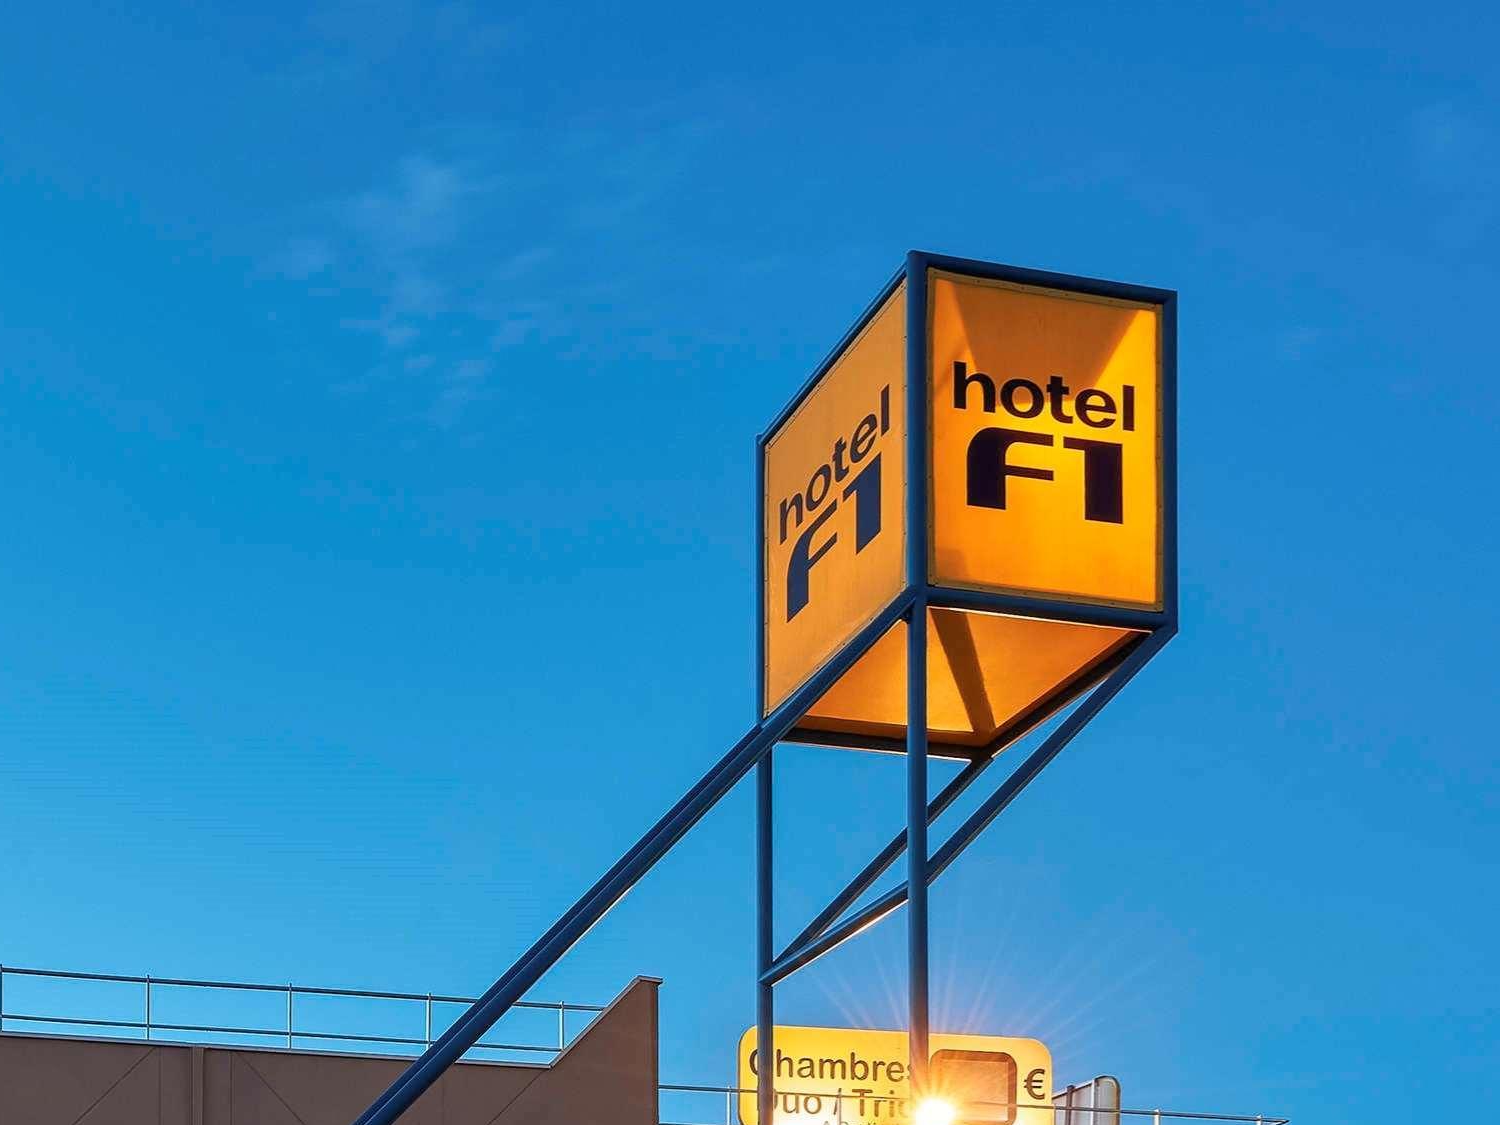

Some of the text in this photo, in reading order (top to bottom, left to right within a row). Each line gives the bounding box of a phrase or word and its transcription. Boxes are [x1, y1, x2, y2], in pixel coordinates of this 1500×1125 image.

[953, 360, 1136, 432] hotel
[779, 383, 890, 545] hotel
[966, 426, 1124, 525] F1
[786, 451, 882, 623] F1
[772, 1088, 822, 1115] uo
